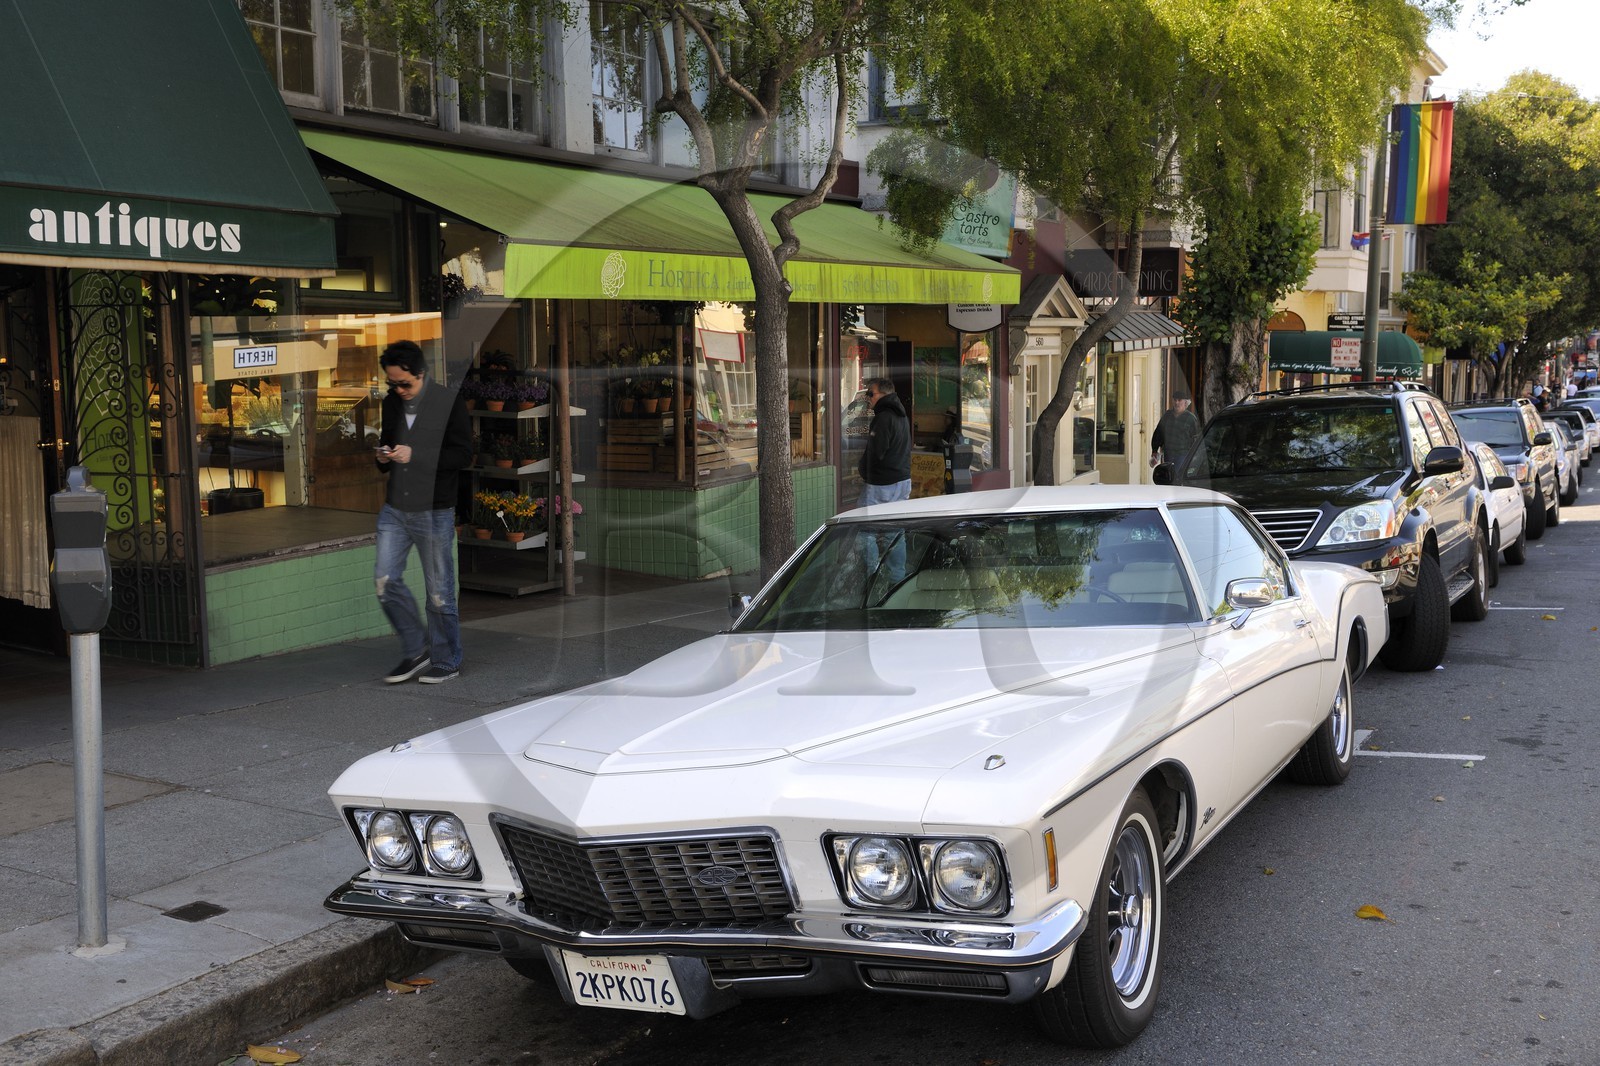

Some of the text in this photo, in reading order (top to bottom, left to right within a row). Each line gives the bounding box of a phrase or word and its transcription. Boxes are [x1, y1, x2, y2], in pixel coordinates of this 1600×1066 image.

[951, 199, 1000, 226] Castro
[29, 201, 241, 257] antiques
[960, 221, 989, 237] tarts
[1035, 337, 1044, 347] 560
[1333, 338, 1341, 347] NO
[847, 345, 869, 361] OPEN
[590, 959, 648, 972] CALIFORNIA
[576, 971, 675, 1006] 2KPK076
